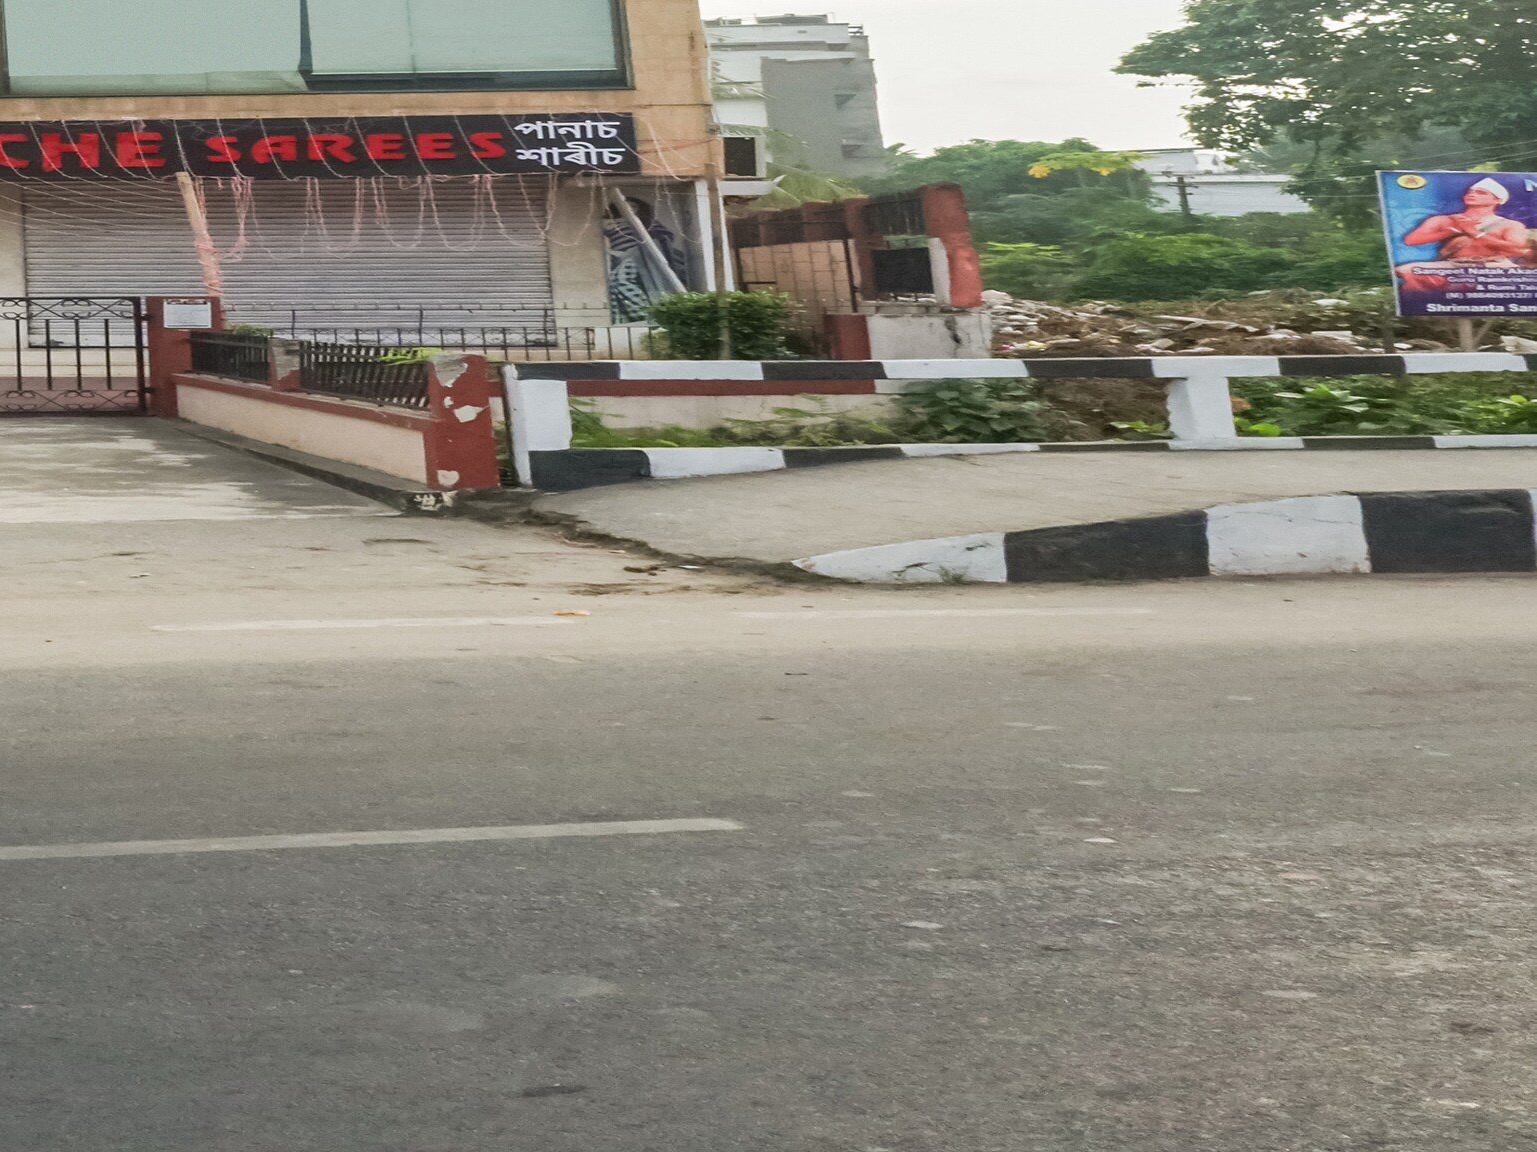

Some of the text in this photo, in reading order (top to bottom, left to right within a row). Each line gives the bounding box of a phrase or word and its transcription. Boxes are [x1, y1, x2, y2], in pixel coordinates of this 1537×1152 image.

[513, 120, 621, 139] পানাচ
[204, 131, 508, 165] SAREES
[1426, 303, 1505, 312] Shrimanta
